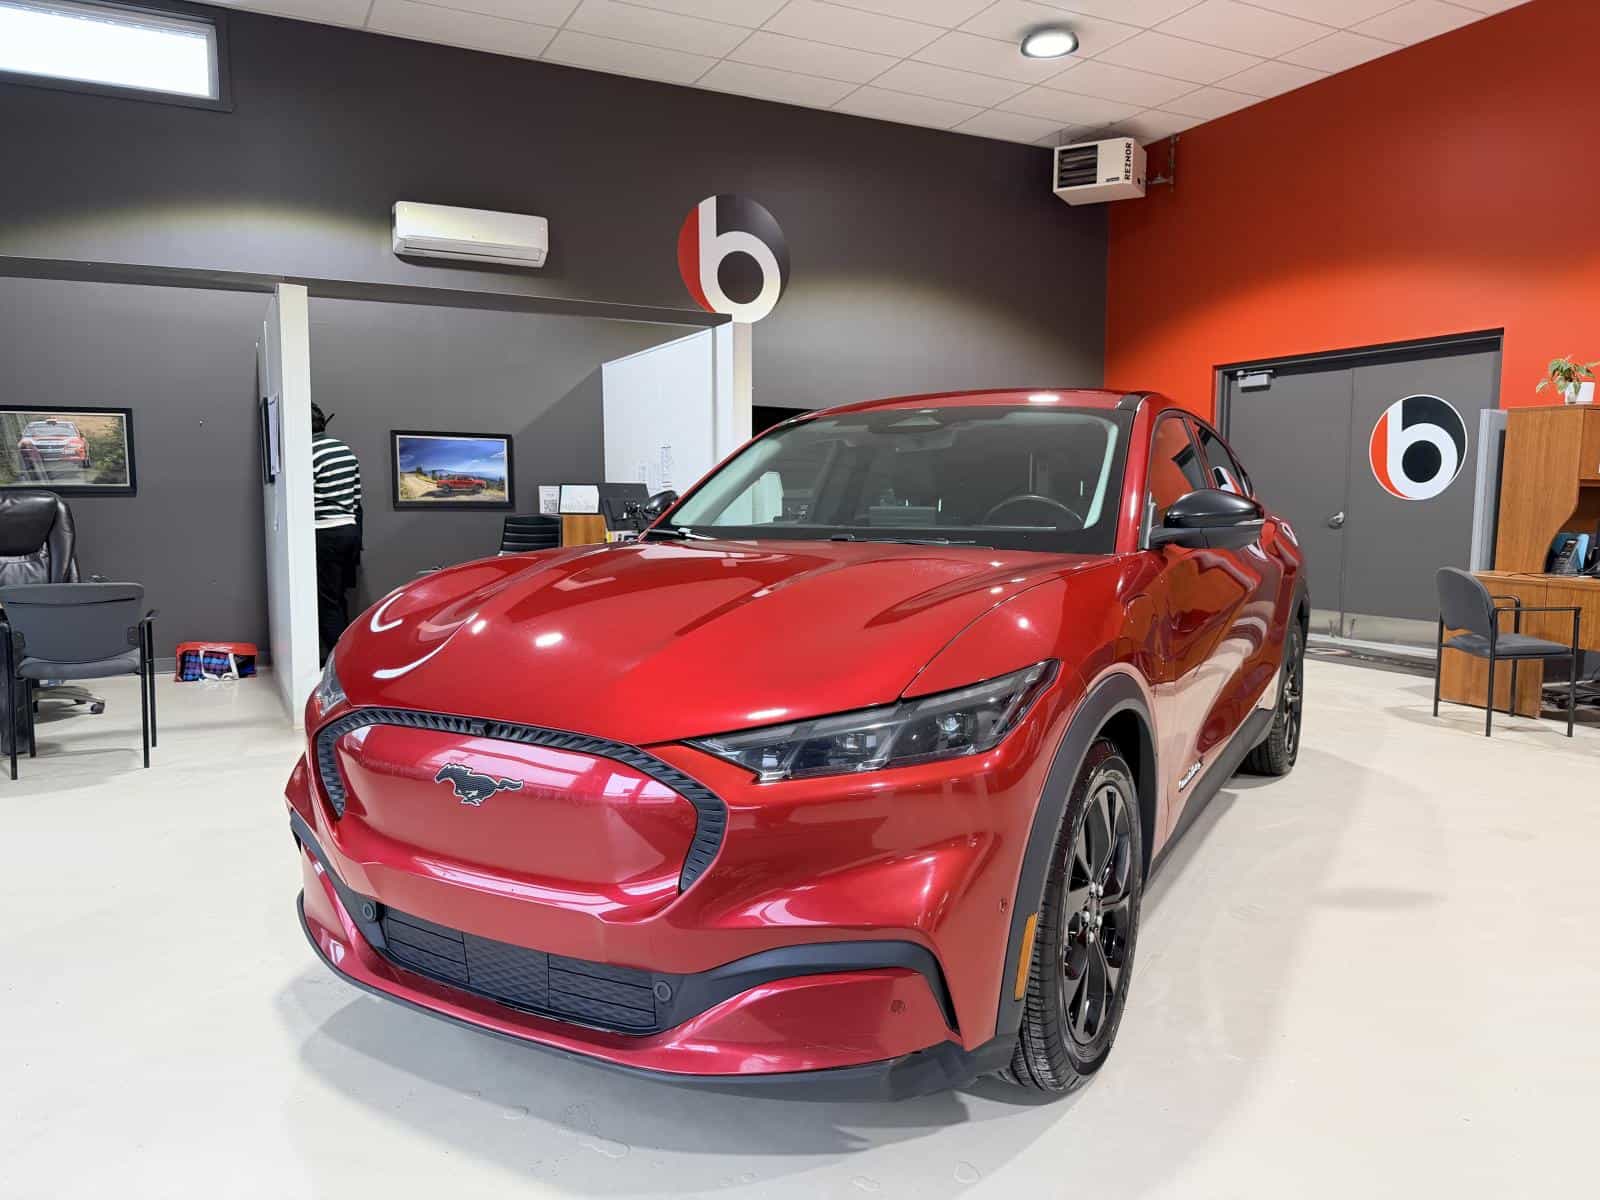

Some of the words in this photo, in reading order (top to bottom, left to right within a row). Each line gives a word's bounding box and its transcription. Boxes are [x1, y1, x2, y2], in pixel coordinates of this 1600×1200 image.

[1124, 142, 1132, 181] REZNOR
[698, 194, 782, 324] b
[1385, 398, 1459, 500] b
